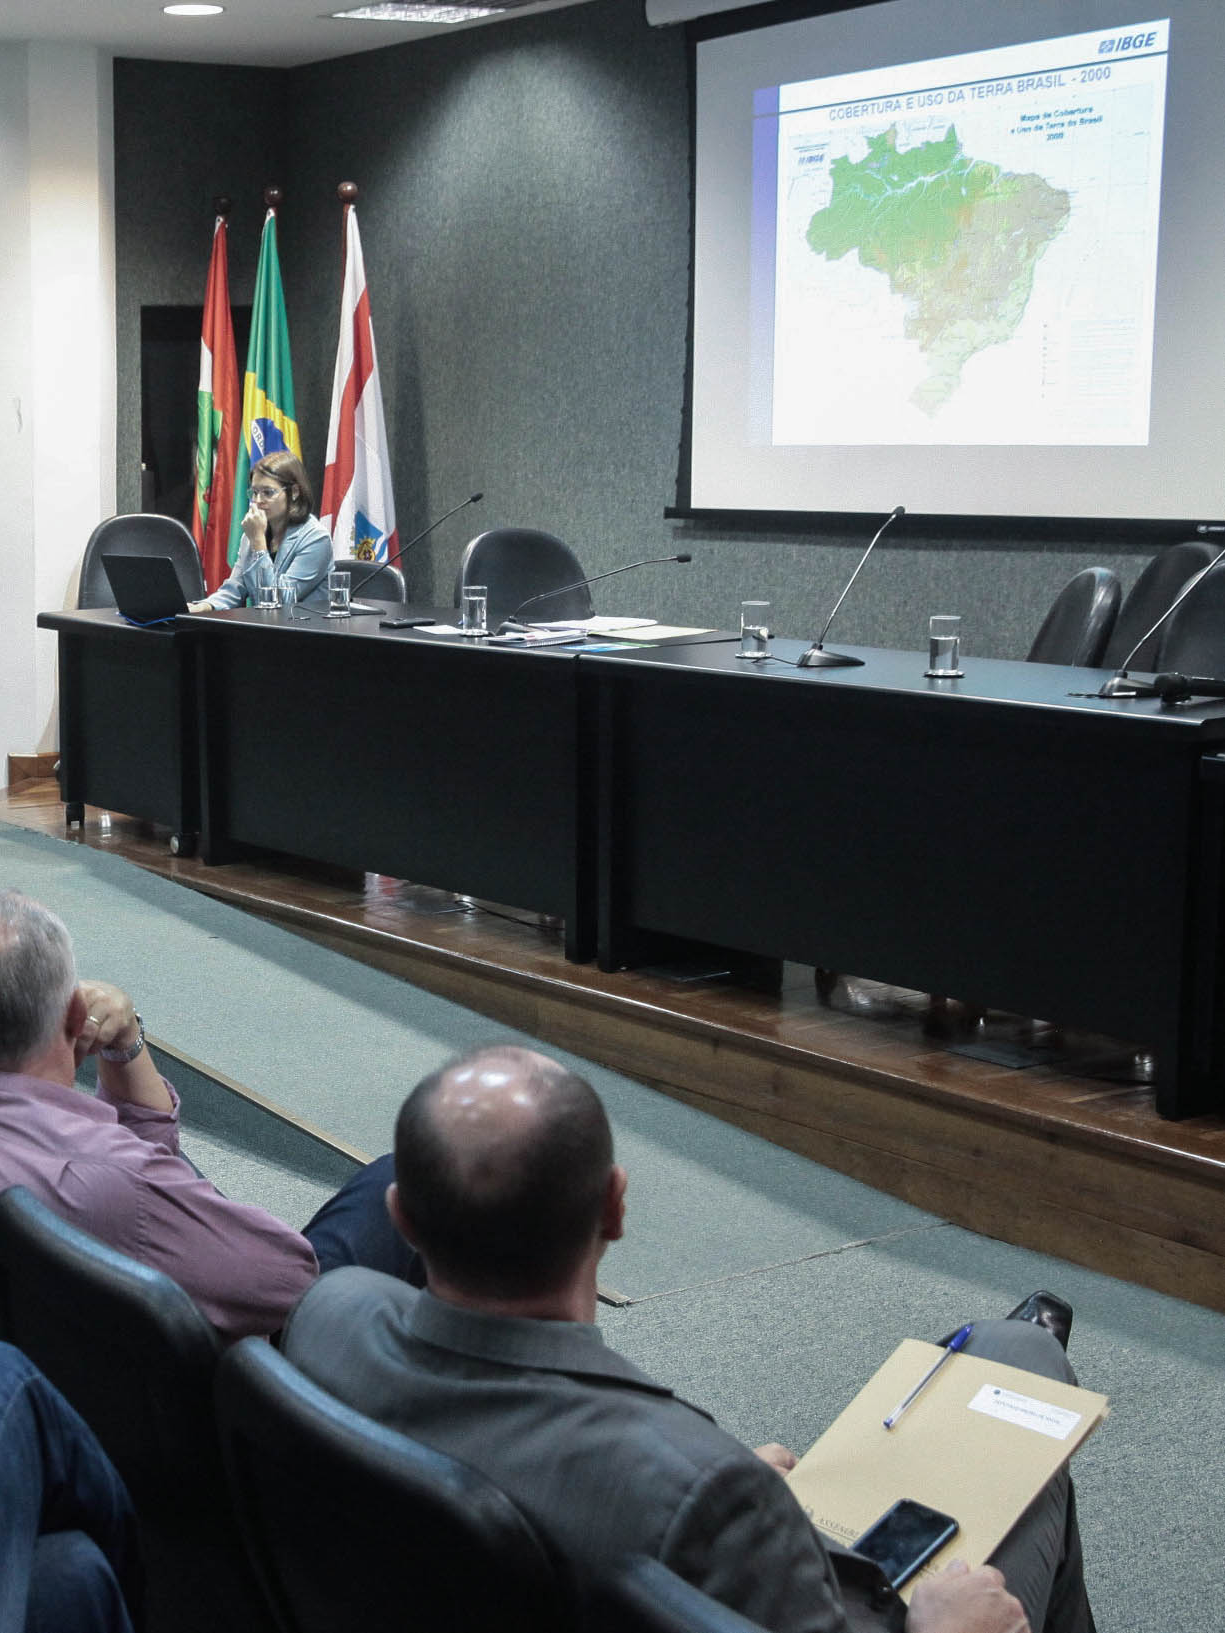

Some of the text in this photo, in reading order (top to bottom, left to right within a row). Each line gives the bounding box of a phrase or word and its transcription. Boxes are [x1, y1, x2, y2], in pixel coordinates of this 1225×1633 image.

[1115, 31, 1157, 53] IBGE
[829, 97, 902, 122] COBERTURA
[906, 95, 914, 110] E
[917, 90, 944, 108] USO
[947, 86, 966, 104] DA
[968, 80, 1014, 101] TERRA
[1017, 72, 1065, 94] BRASIL
[1080, 65, 1112, 84] 2000
[1079, 115, 1103, 126] Brasil
[253, 427, 264, 447] ORD
